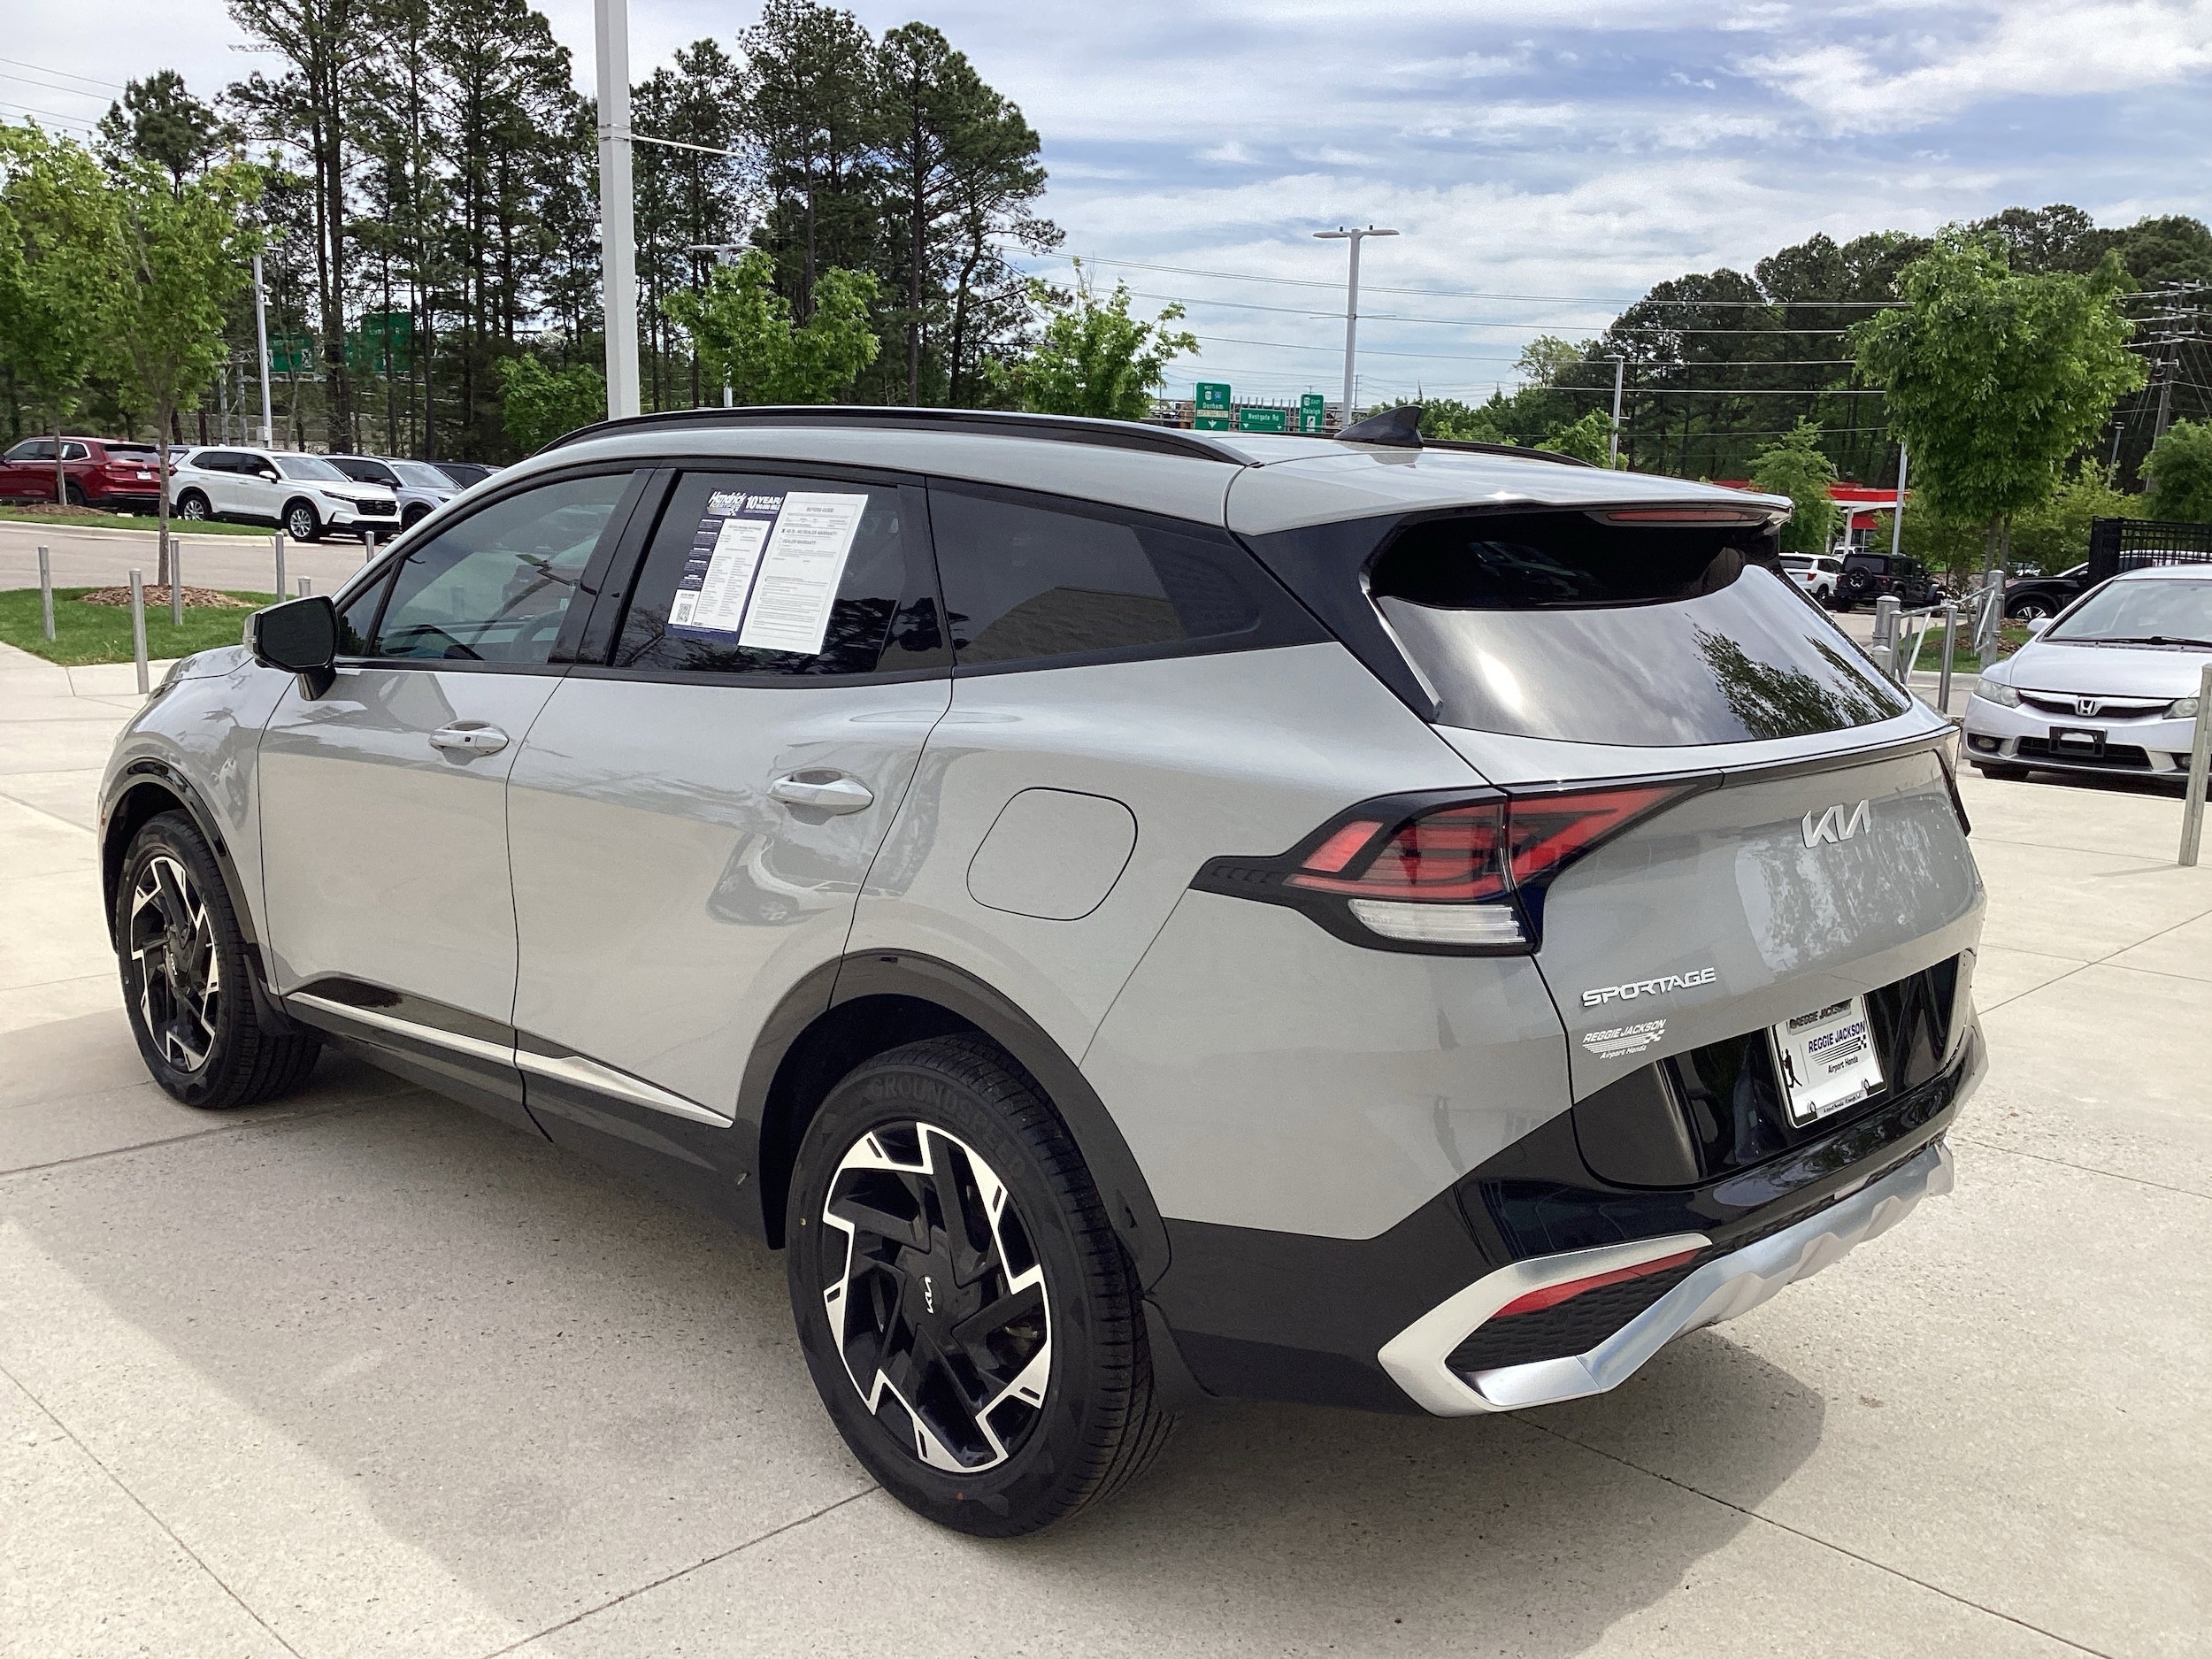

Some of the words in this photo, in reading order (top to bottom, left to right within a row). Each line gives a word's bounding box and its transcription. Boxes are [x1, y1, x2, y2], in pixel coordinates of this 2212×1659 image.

[708, 491, 747, 508] Hendrick
[746, 495, 758, 510] 10
[1801, 798, 1871, 849] KIA
[1582, 967, 1717, 1007] SPORTAGE
[1582, 1027, 1622, 1043] REGGIE
[1620, 1019, 1667, 1037] JACKSON
[1808, 1033, 1834, 1053] REGGIE
[1834, 1020, 1866, 1044] JACKSON
[1600, 1049, 1626, 1060] Airport
[1626, 1044, 1647, 1055] Honda
[1827, 1061, 1845, 1074] Airport
[1844, 1056, 1859, 1067] Honda
